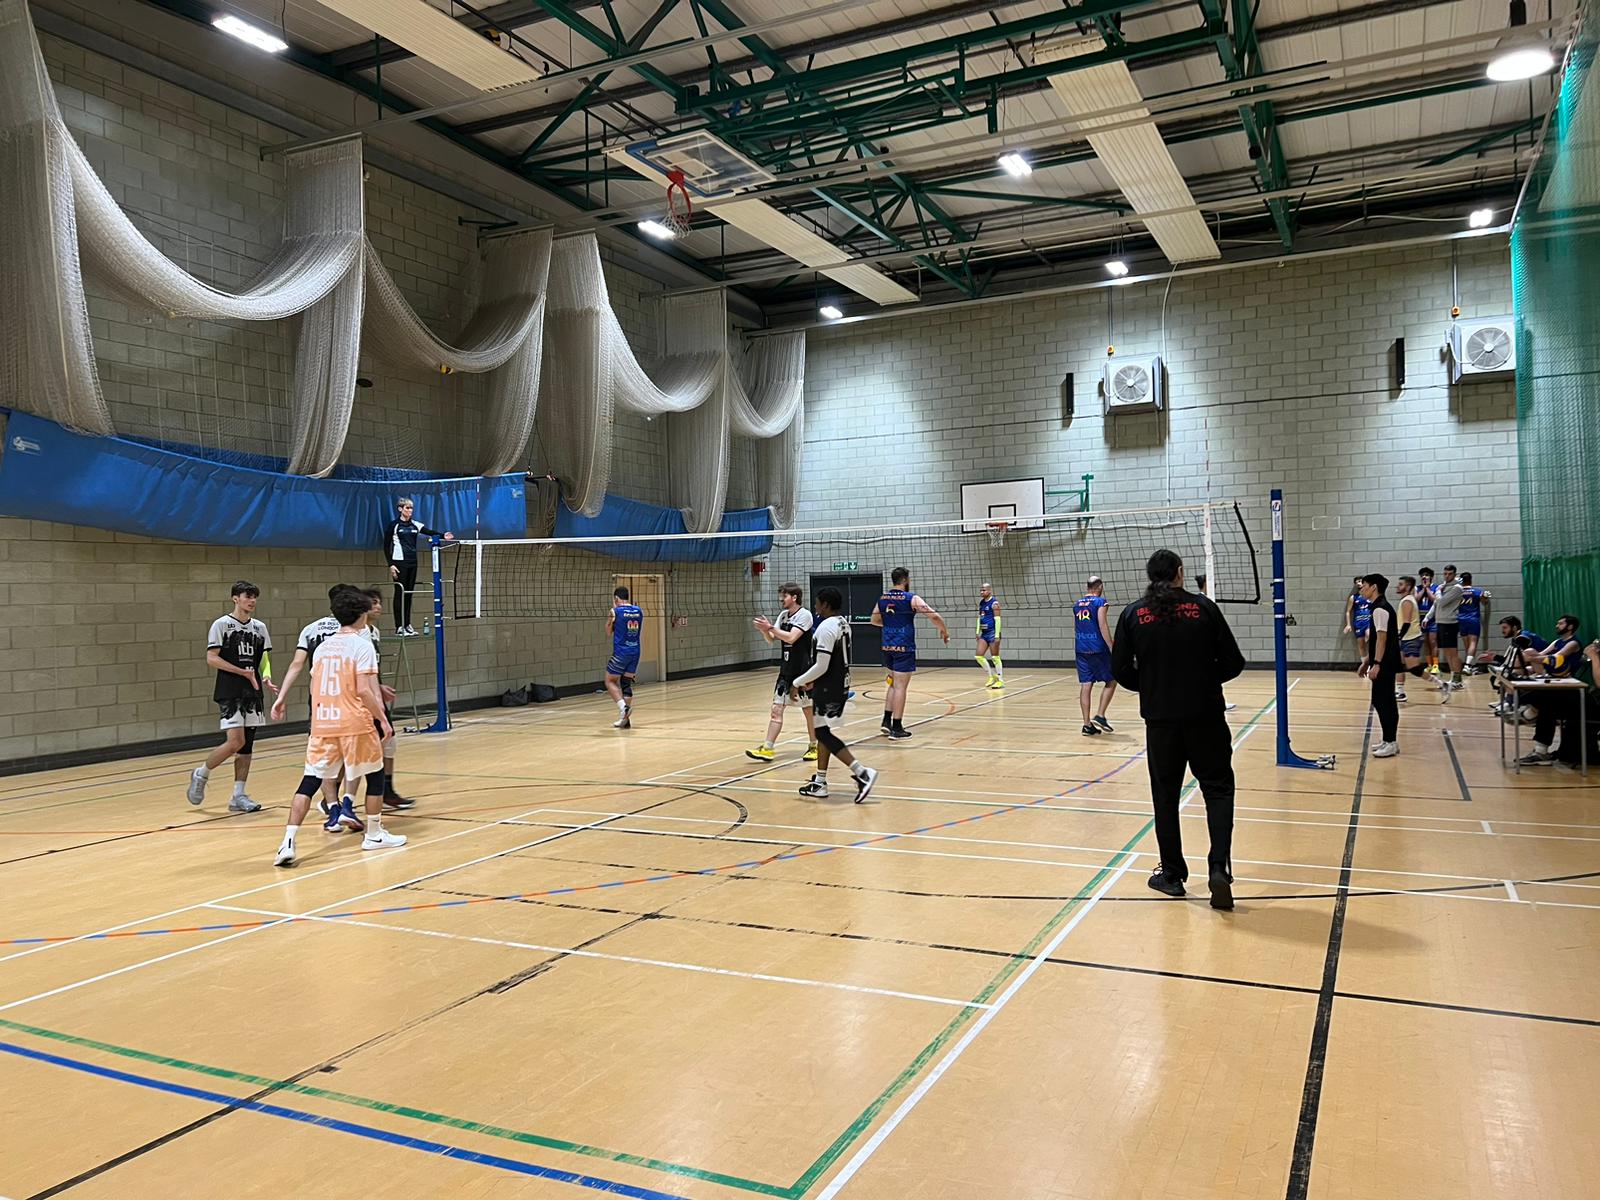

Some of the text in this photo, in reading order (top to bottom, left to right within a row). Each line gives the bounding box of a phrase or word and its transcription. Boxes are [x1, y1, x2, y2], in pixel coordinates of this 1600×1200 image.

[1076, 609, 1091, 622] 18
[1184, 610, 1200, 618] VC
[320, 657, 341, 696] 15
